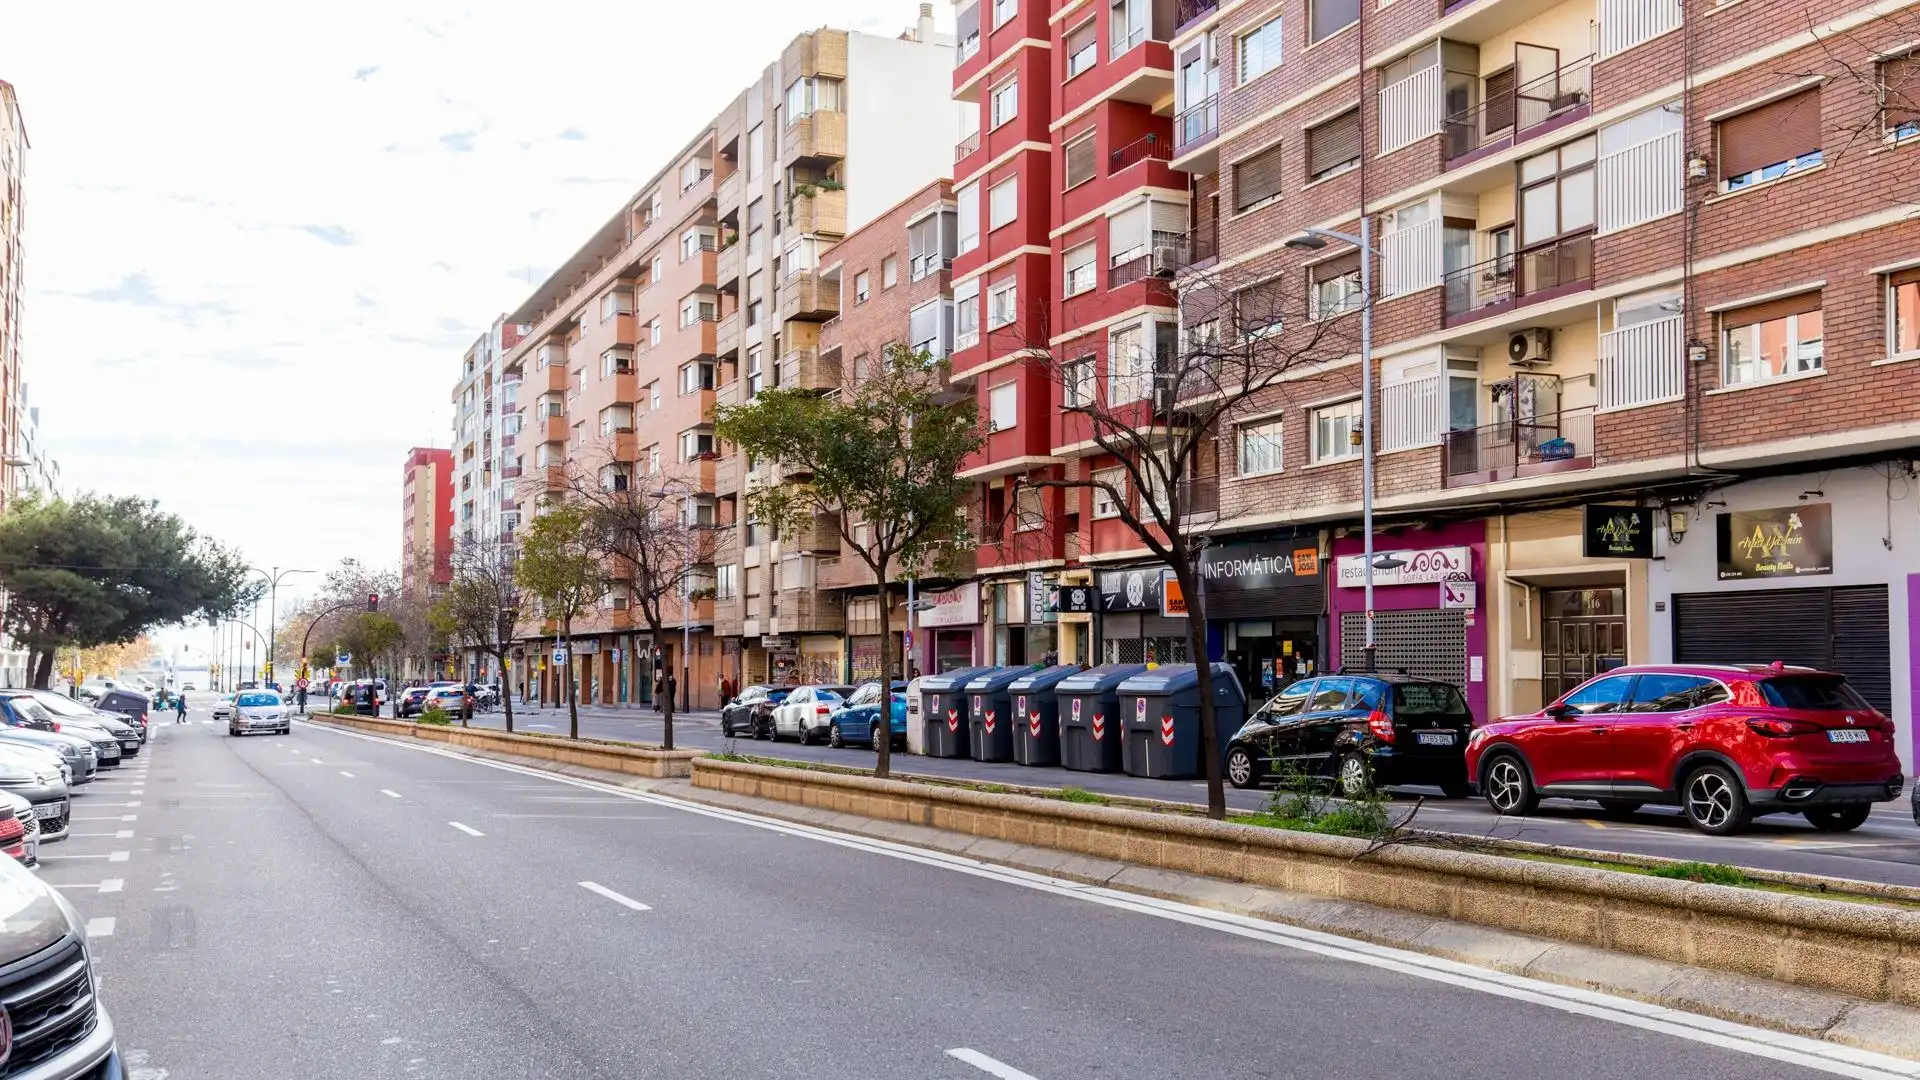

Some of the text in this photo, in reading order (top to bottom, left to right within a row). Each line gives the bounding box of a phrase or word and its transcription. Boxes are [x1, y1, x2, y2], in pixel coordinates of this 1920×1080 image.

[1204, 553, 1294, 579] INFORMÁTICA
[1755, 563, 1777, 572] Beauty
[1777, 561, 1794, 570] Nails
[1031, 574, 1043, 622] Laura
